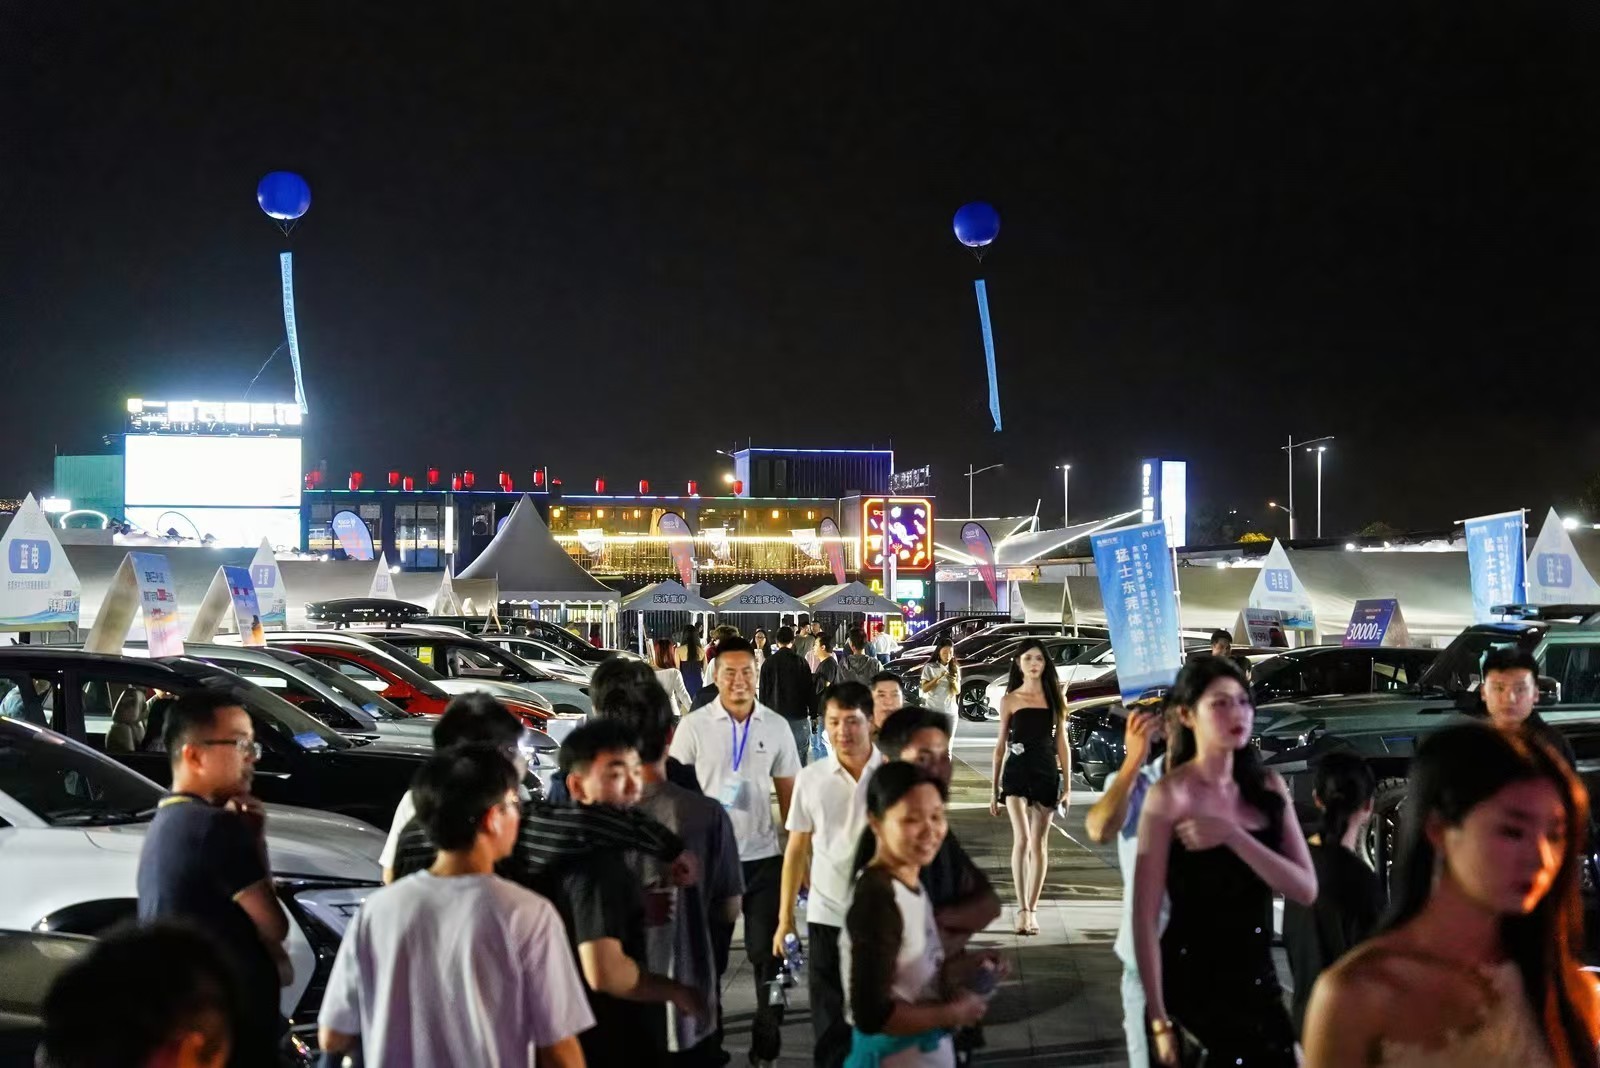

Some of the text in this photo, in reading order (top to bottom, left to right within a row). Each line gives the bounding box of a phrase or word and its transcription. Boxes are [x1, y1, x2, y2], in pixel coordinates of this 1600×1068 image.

[653, 593, 688, 604] 反诈宣传
[740, 594, 784, 604] 安全指挥中心
